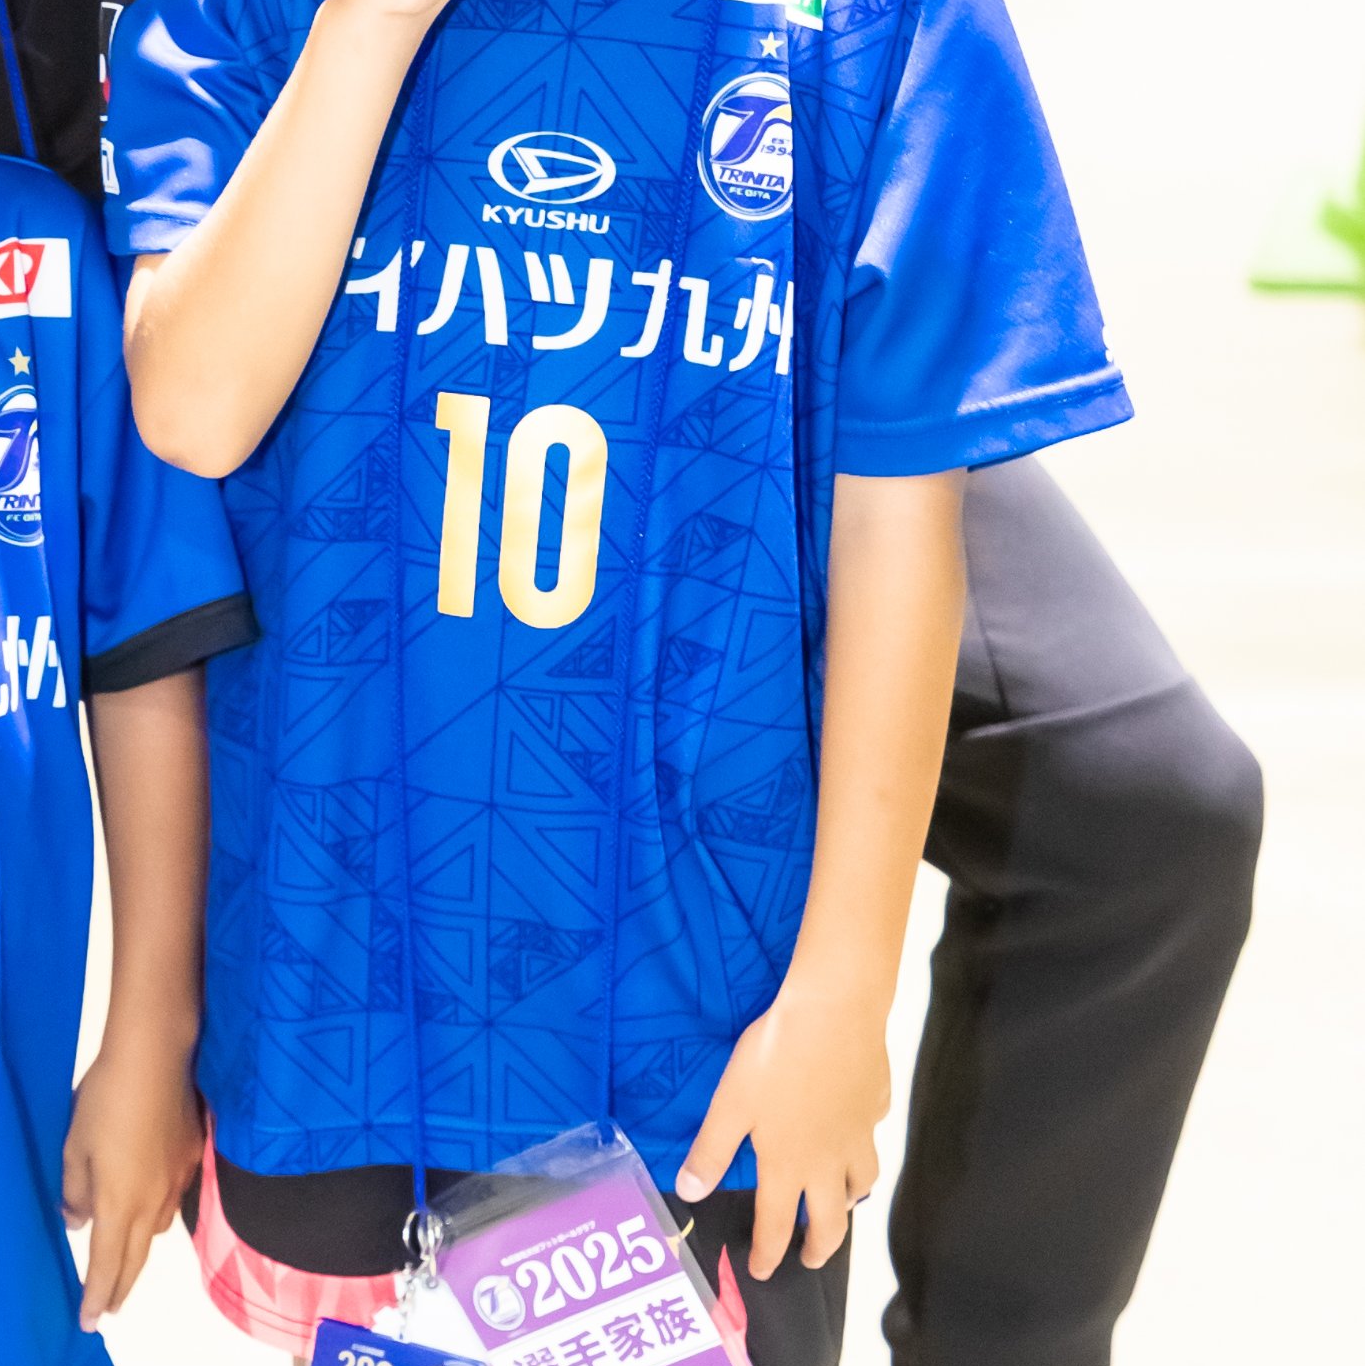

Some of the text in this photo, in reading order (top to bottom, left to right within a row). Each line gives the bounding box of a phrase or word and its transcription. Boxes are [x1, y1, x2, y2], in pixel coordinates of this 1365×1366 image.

[482, 203, 610, 234] KYUSHU
[719, 166, 785, 189] TRINITA
[345, 237, 794, 375] イハツ九州
[435, 392, 609, 630] 10
[515, 1214, 666, 1319] 2025
